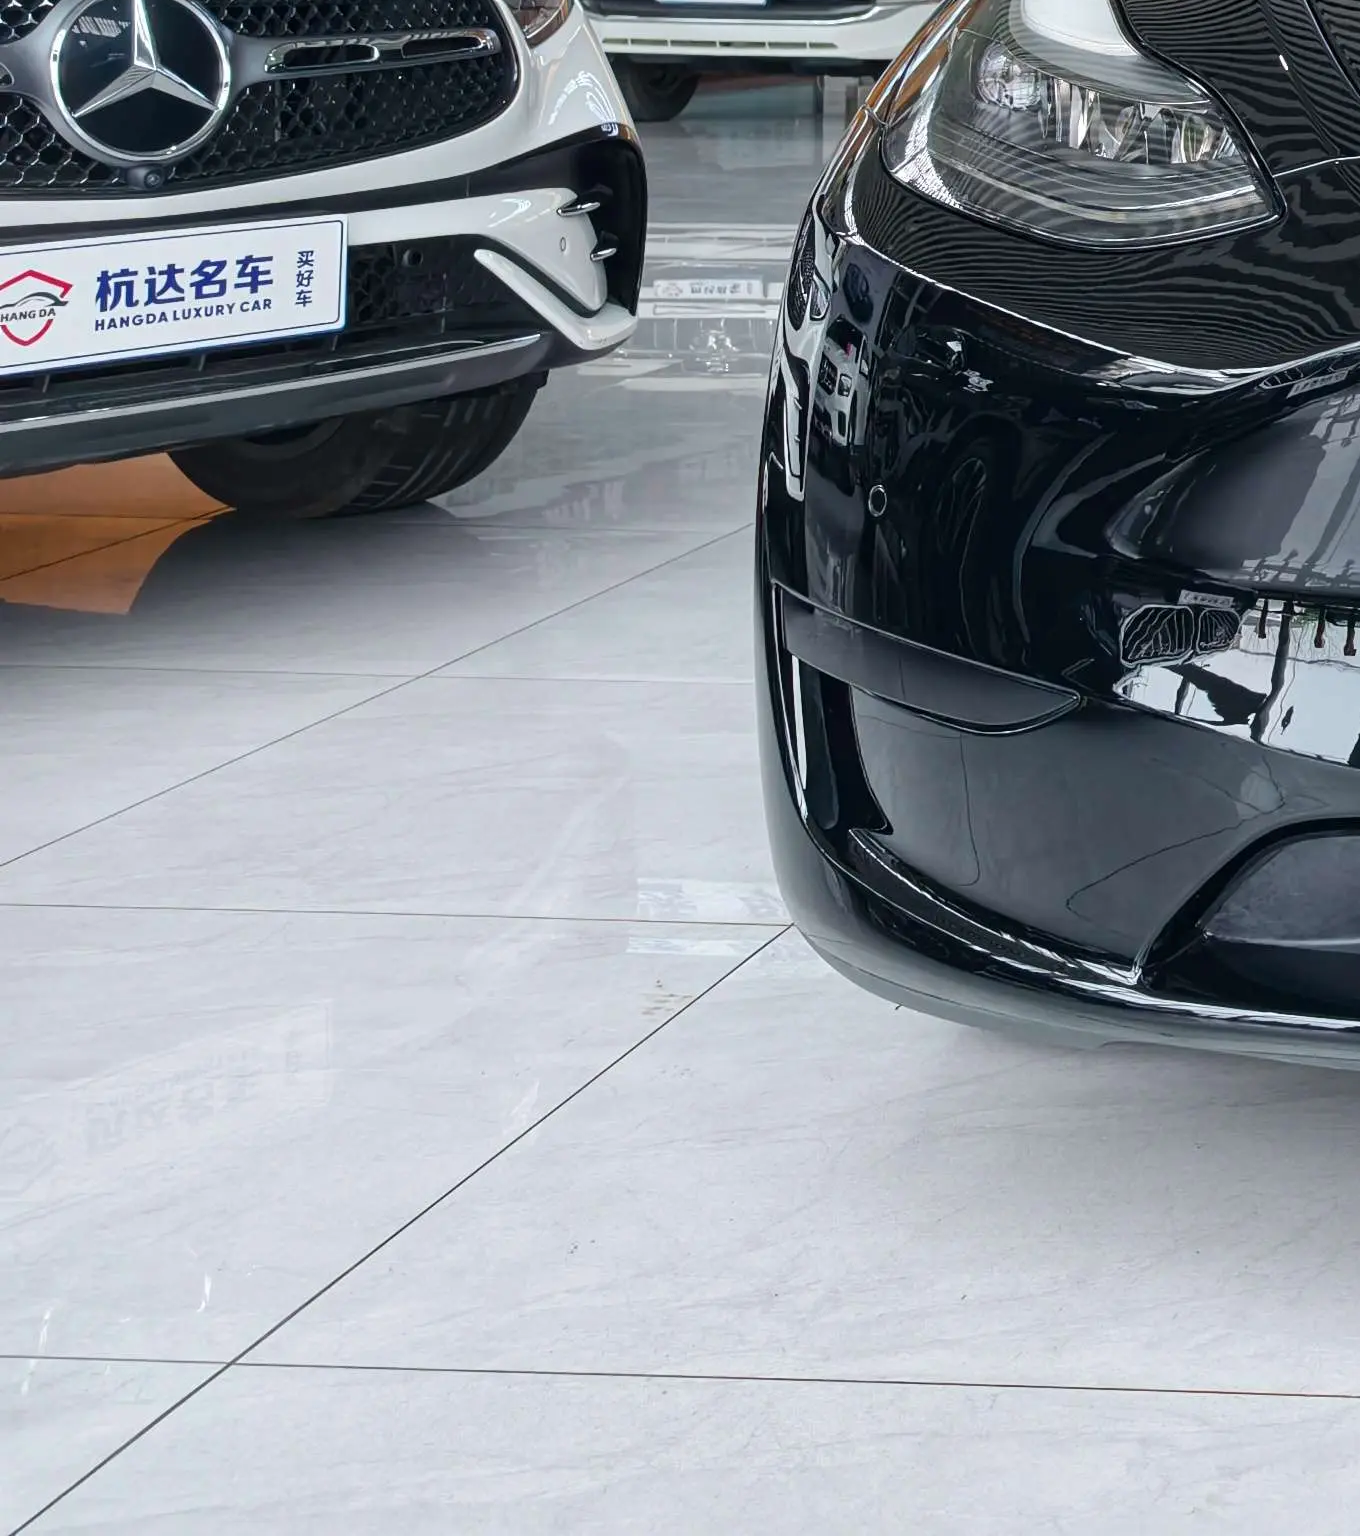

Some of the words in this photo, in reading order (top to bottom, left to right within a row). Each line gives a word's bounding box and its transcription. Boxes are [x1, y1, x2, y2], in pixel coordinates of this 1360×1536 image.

[95, 254, 274, 313] 杭达名车
[295, 249, 315, 308] 买好车
[0, 310, 36, 322] HANG
[39, 308, 56, 318] DA
[94, 311, 168, 332] HANGDA
[172, 303, 236, 322] LUXURY
[239, 298, 272, 313] CAR
